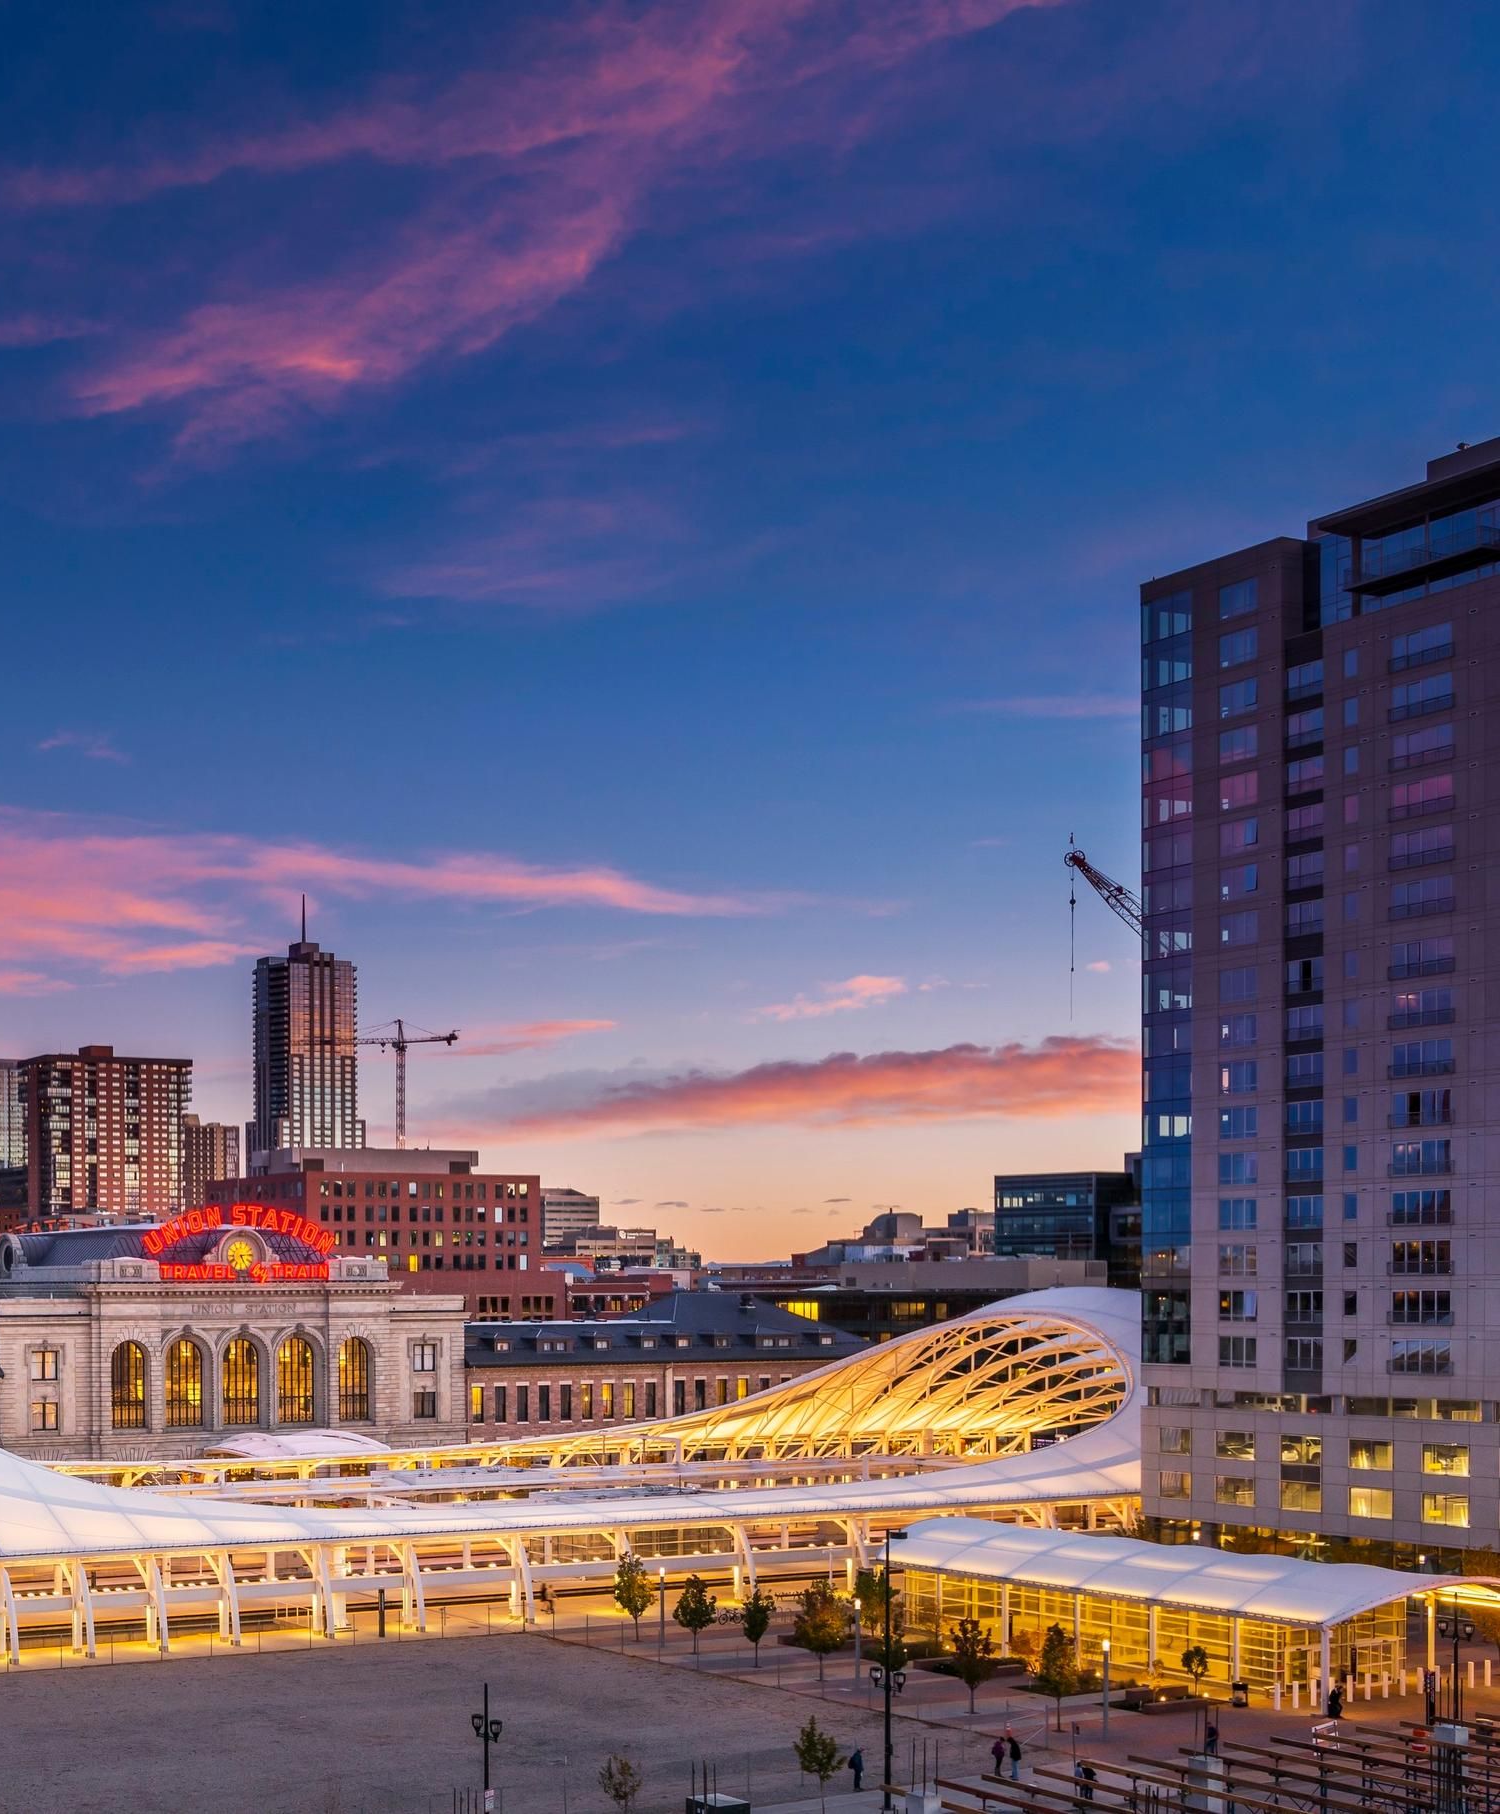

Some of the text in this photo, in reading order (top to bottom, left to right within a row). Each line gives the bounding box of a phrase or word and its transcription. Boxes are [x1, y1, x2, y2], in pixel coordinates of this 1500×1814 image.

[143, 1205, 334, 1255] UNION STATION
[160, 1263, 329, 1284] TRAVEL by TRAIN
[191, 1304, 296, 1314] UNION STATION
